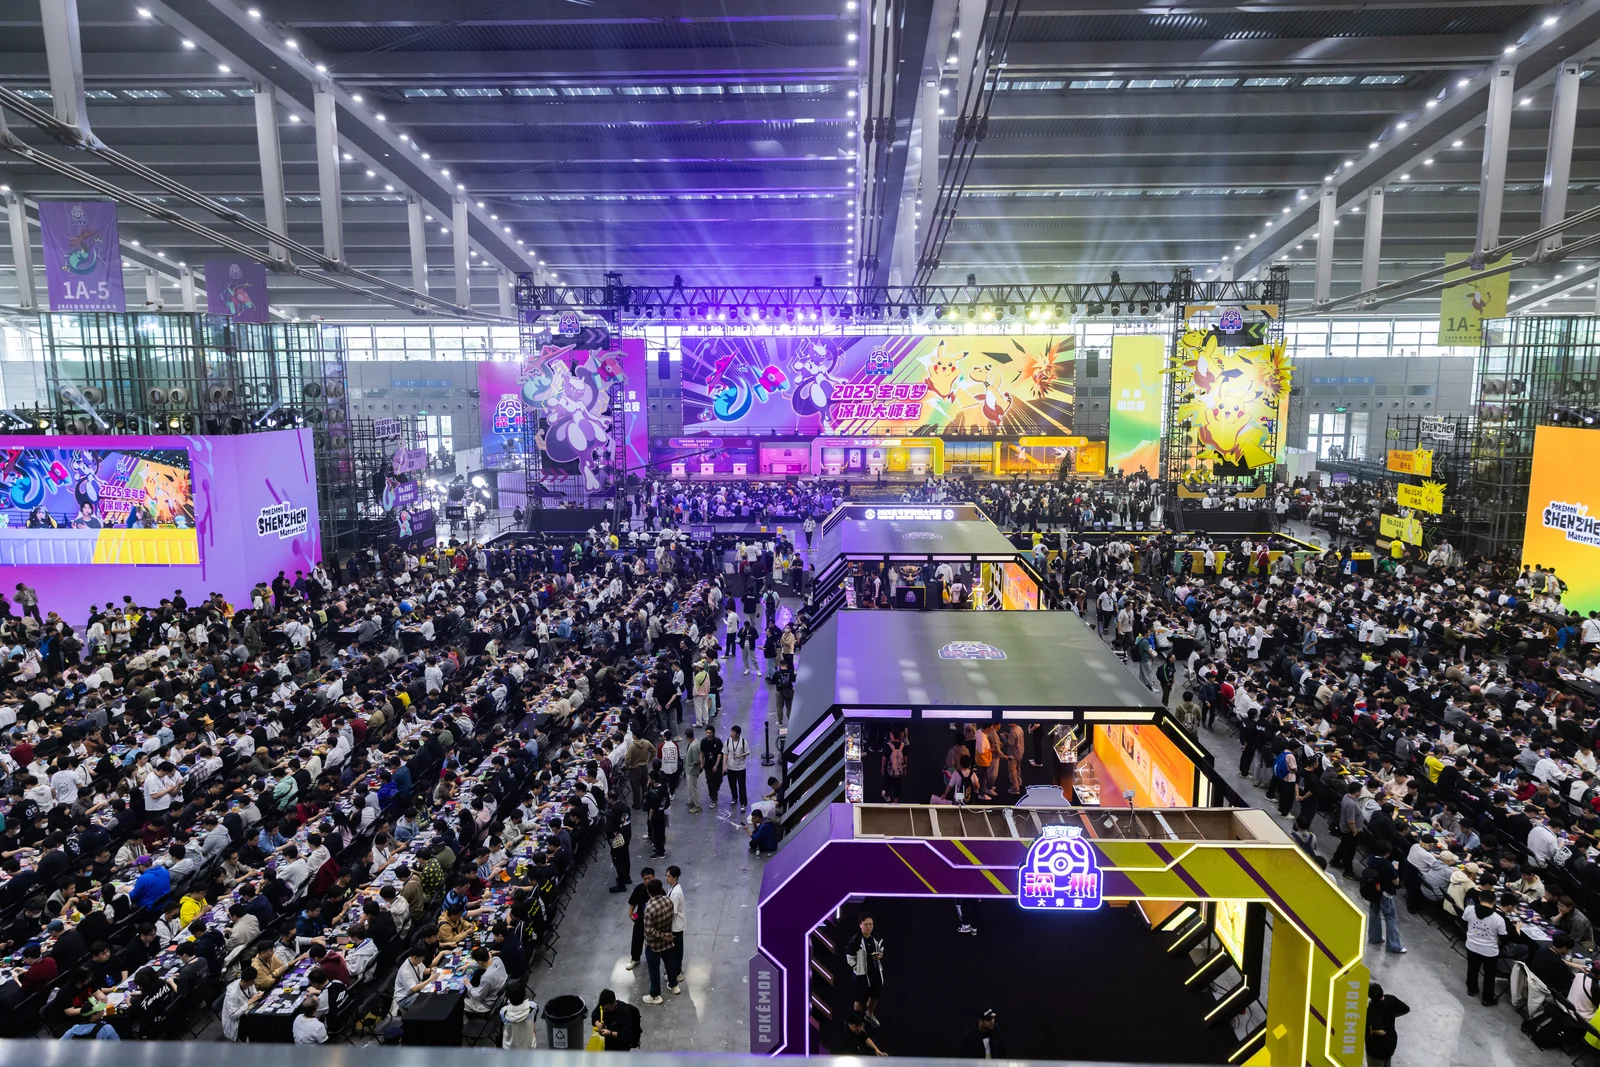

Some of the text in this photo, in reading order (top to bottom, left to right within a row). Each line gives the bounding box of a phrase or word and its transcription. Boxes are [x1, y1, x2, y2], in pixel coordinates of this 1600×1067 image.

[63, 281, 109, 299] 1A-5
[832, 385, 928, 399] 2025 宝可梦
[838, 403, 920, 418] 深圳大师赛
[1421, 421, 1455, 434] SHENZHEN
[99, 486, 121, 497] 2025
[1404, 487, 1423, 497] No.0145
[105, 500, 132, 511] 深圳大
[1551, 503, 1577, 514] POKÉMON
[258, 509, 307, 535] SHENZHEN
[1567, 531, 1593, 544] Masters
[663, 747, 676, 760] 12
[755, 971, 771, 1043] POKÉMON
[1342, 981, 1361, 1054] POKÉMON
